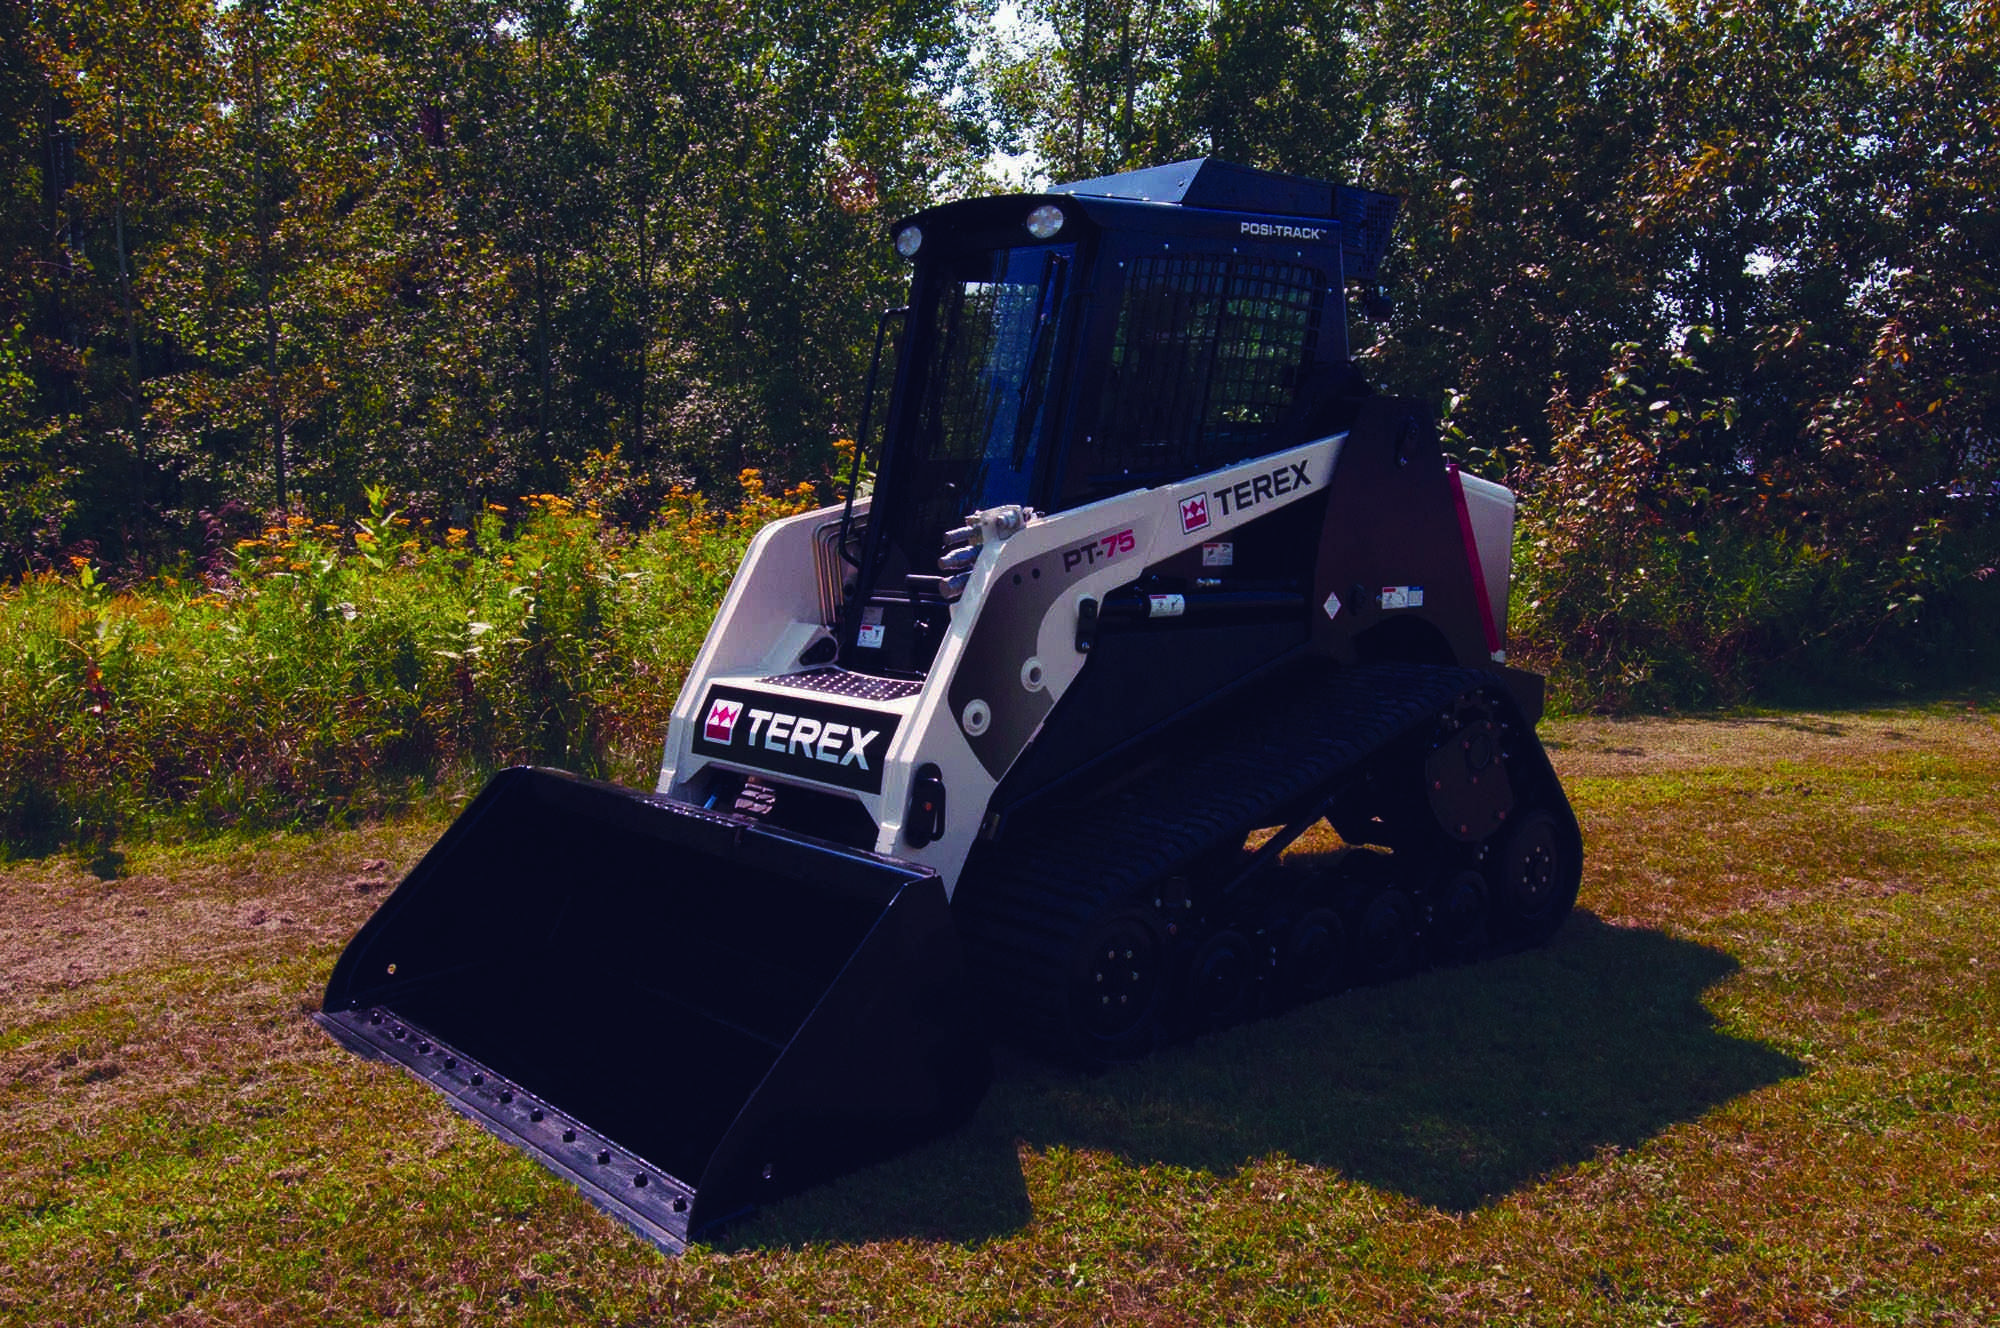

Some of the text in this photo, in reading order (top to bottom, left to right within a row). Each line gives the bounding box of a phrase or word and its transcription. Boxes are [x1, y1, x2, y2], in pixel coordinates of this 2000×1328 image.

[1214, 460, 1312, 516] TEREX
[1063, 529, 1136, 573] PT-75
[747, 709, 880, 771] TEREX
